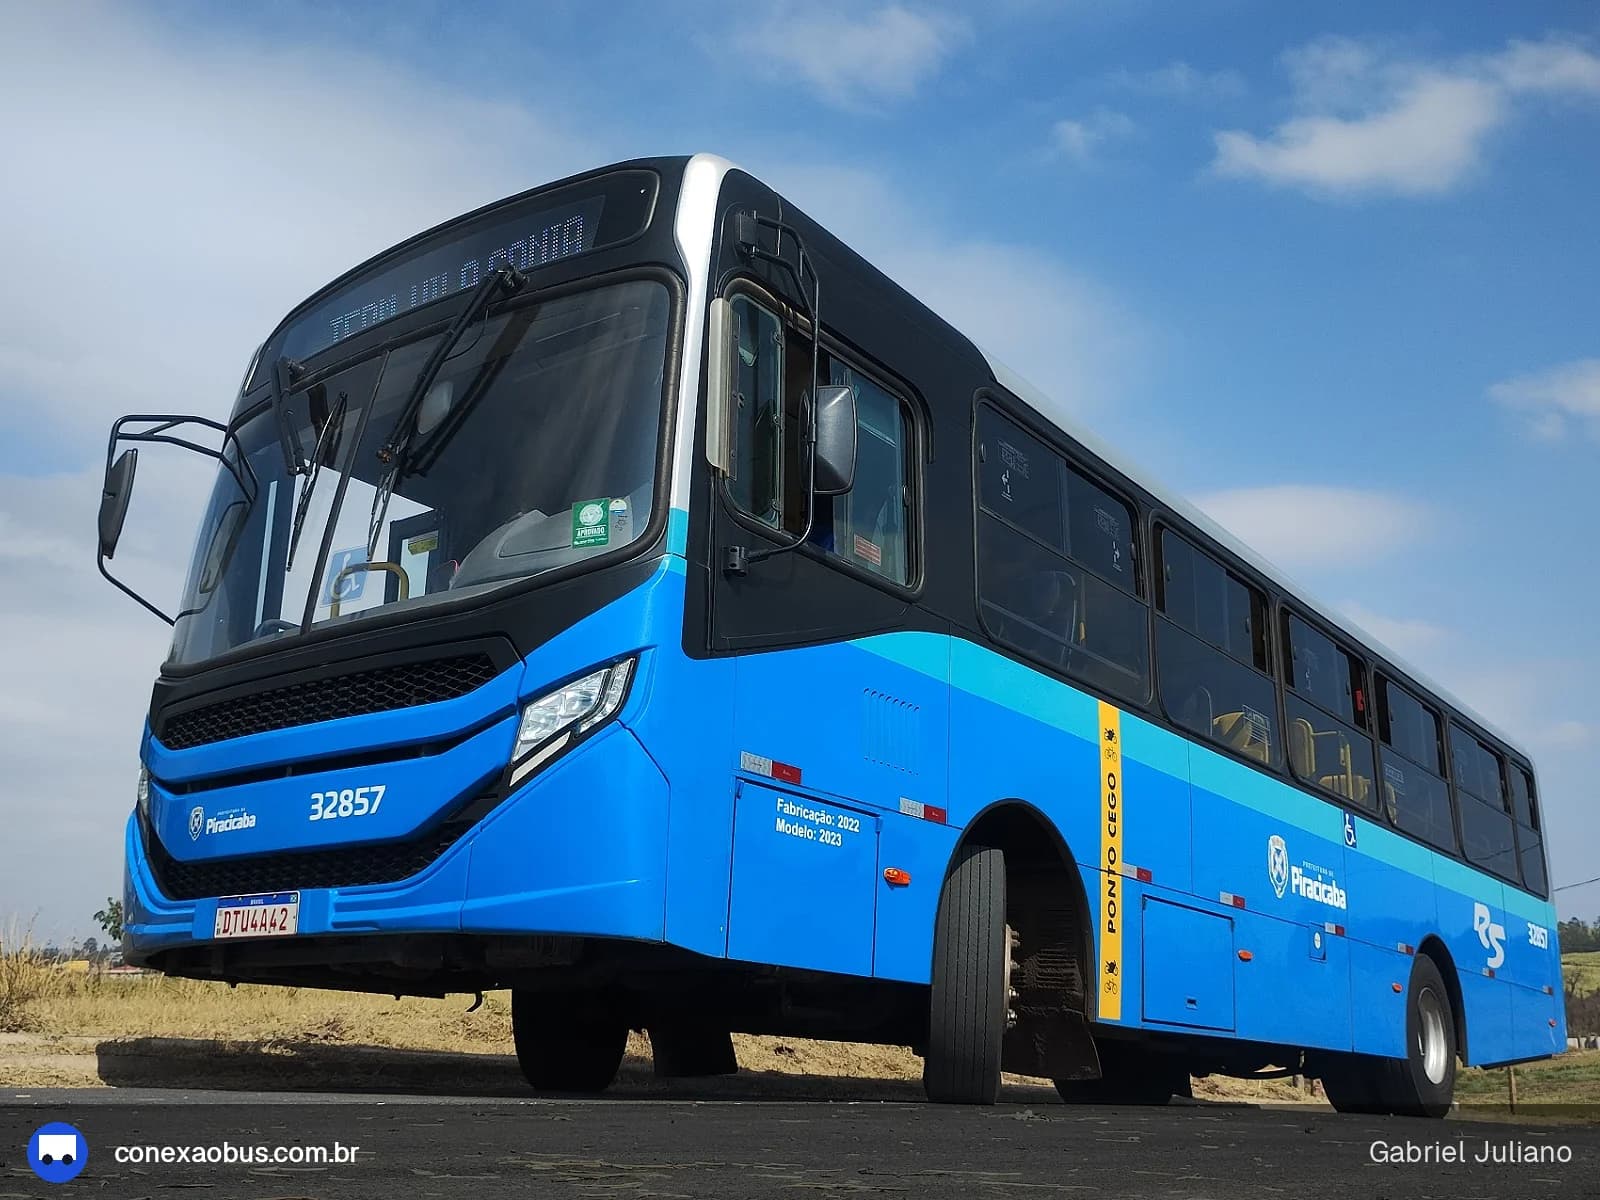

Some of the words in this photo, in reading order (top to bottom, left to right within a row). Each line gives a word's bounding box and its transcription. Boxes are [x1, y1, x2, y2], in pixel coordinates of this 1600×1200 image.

[309, 785, 386, 821] 32857
[776, 797, 836, 826] Fabricação:
[837, 814, 860, 833] 2022
[1107, 772, 1118, 838] CEGO
[205, 812, 256, 835] Piracicaba
[775, 817, 817, 841] Modelo:
[819, 828, 843, 847] 2023
[1107, 846, 1118, 934] PONTO
[1291, 865, 1347, 910] Piracicaba
[222, 907, 288, 934] DTU4A42
[1473, 902, 1506, 969] RS
